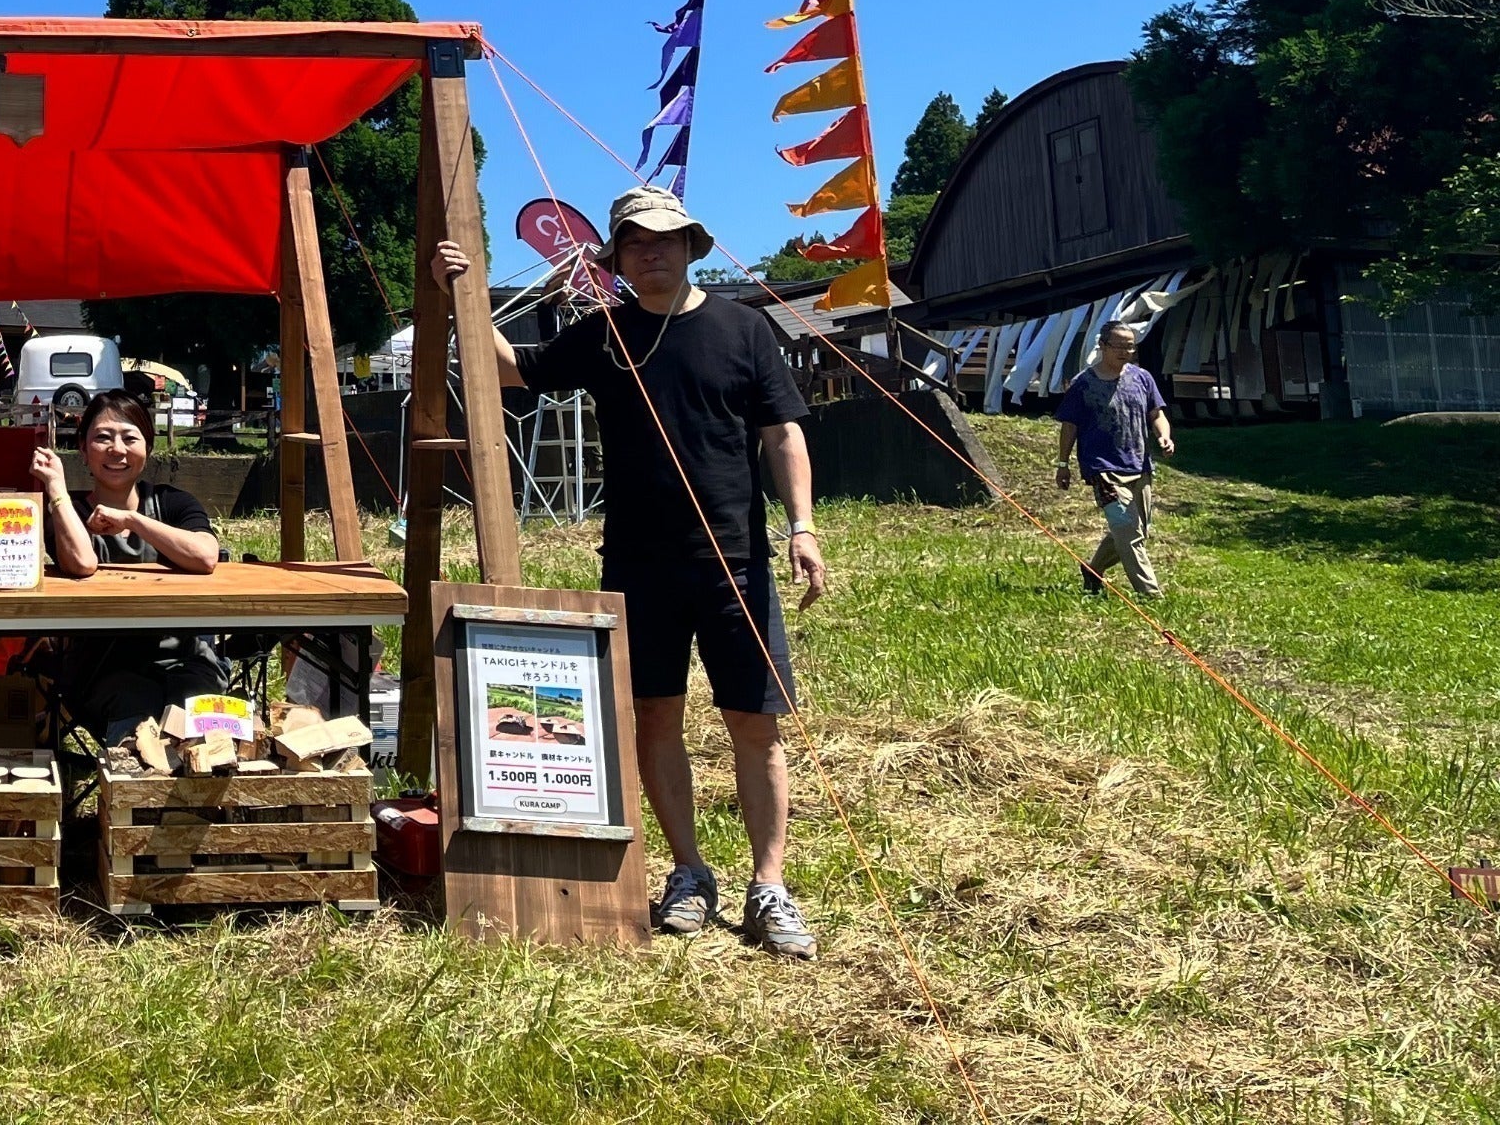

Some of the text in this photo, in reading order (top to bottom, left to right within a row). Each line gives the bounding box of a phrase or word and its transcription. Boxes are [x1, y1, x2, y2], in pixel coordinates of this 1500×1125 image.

[483, 656, 578, 672] TAKIGIキャンドルを
[519, 800, 561, 810] KURA CAMP
